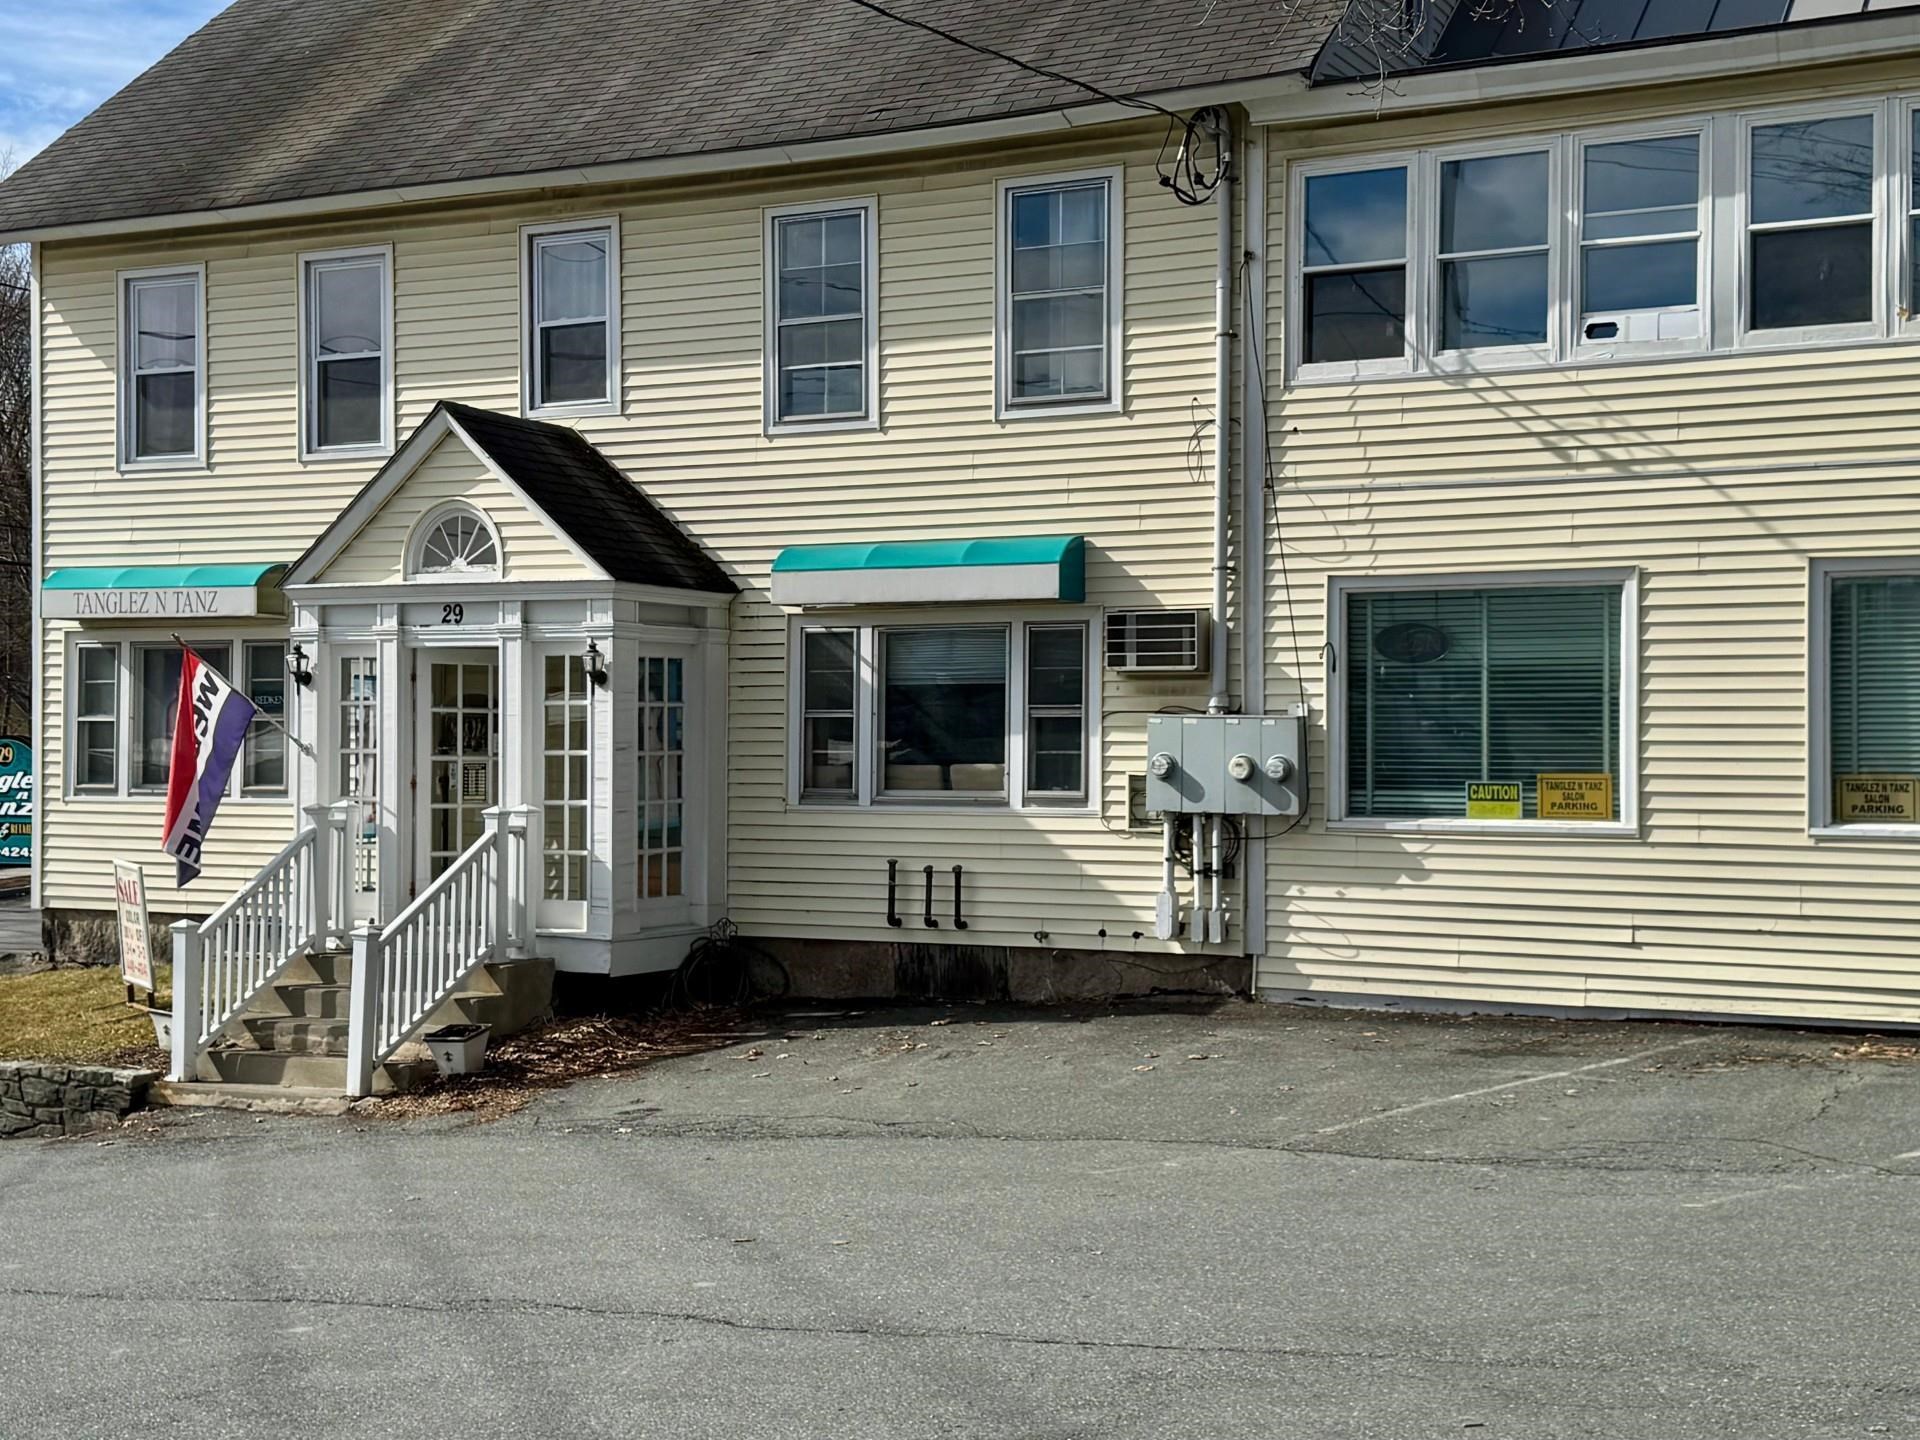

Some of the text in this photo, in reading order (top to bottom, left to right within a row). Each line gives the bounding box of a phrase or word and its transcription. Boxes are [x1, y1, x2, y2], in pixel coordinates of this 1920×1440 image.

[73, 590, 218, 615] TANGLEZ N TANZ
[441, 603, 464, 624] 29
[1545, 781, 1576, 791] TANGLEZ
[1584, 781, 1603, 791] TANZ
[1845, 783, 1880, 793] TANGLEZ
[1889, 783, 1910, 793] TANZ
[1470, 784, 1518, 800] CAUTION
[1562, 791, 1585, 801] SALON
[1864, 794, 1889, 804] SALON
[0, 801, 32, 816] nz
[1550, 802, 1598, 811] PARKING
[1851, 805, 1904, 814] PARKING
[118, 876, 141, 906] SALE
